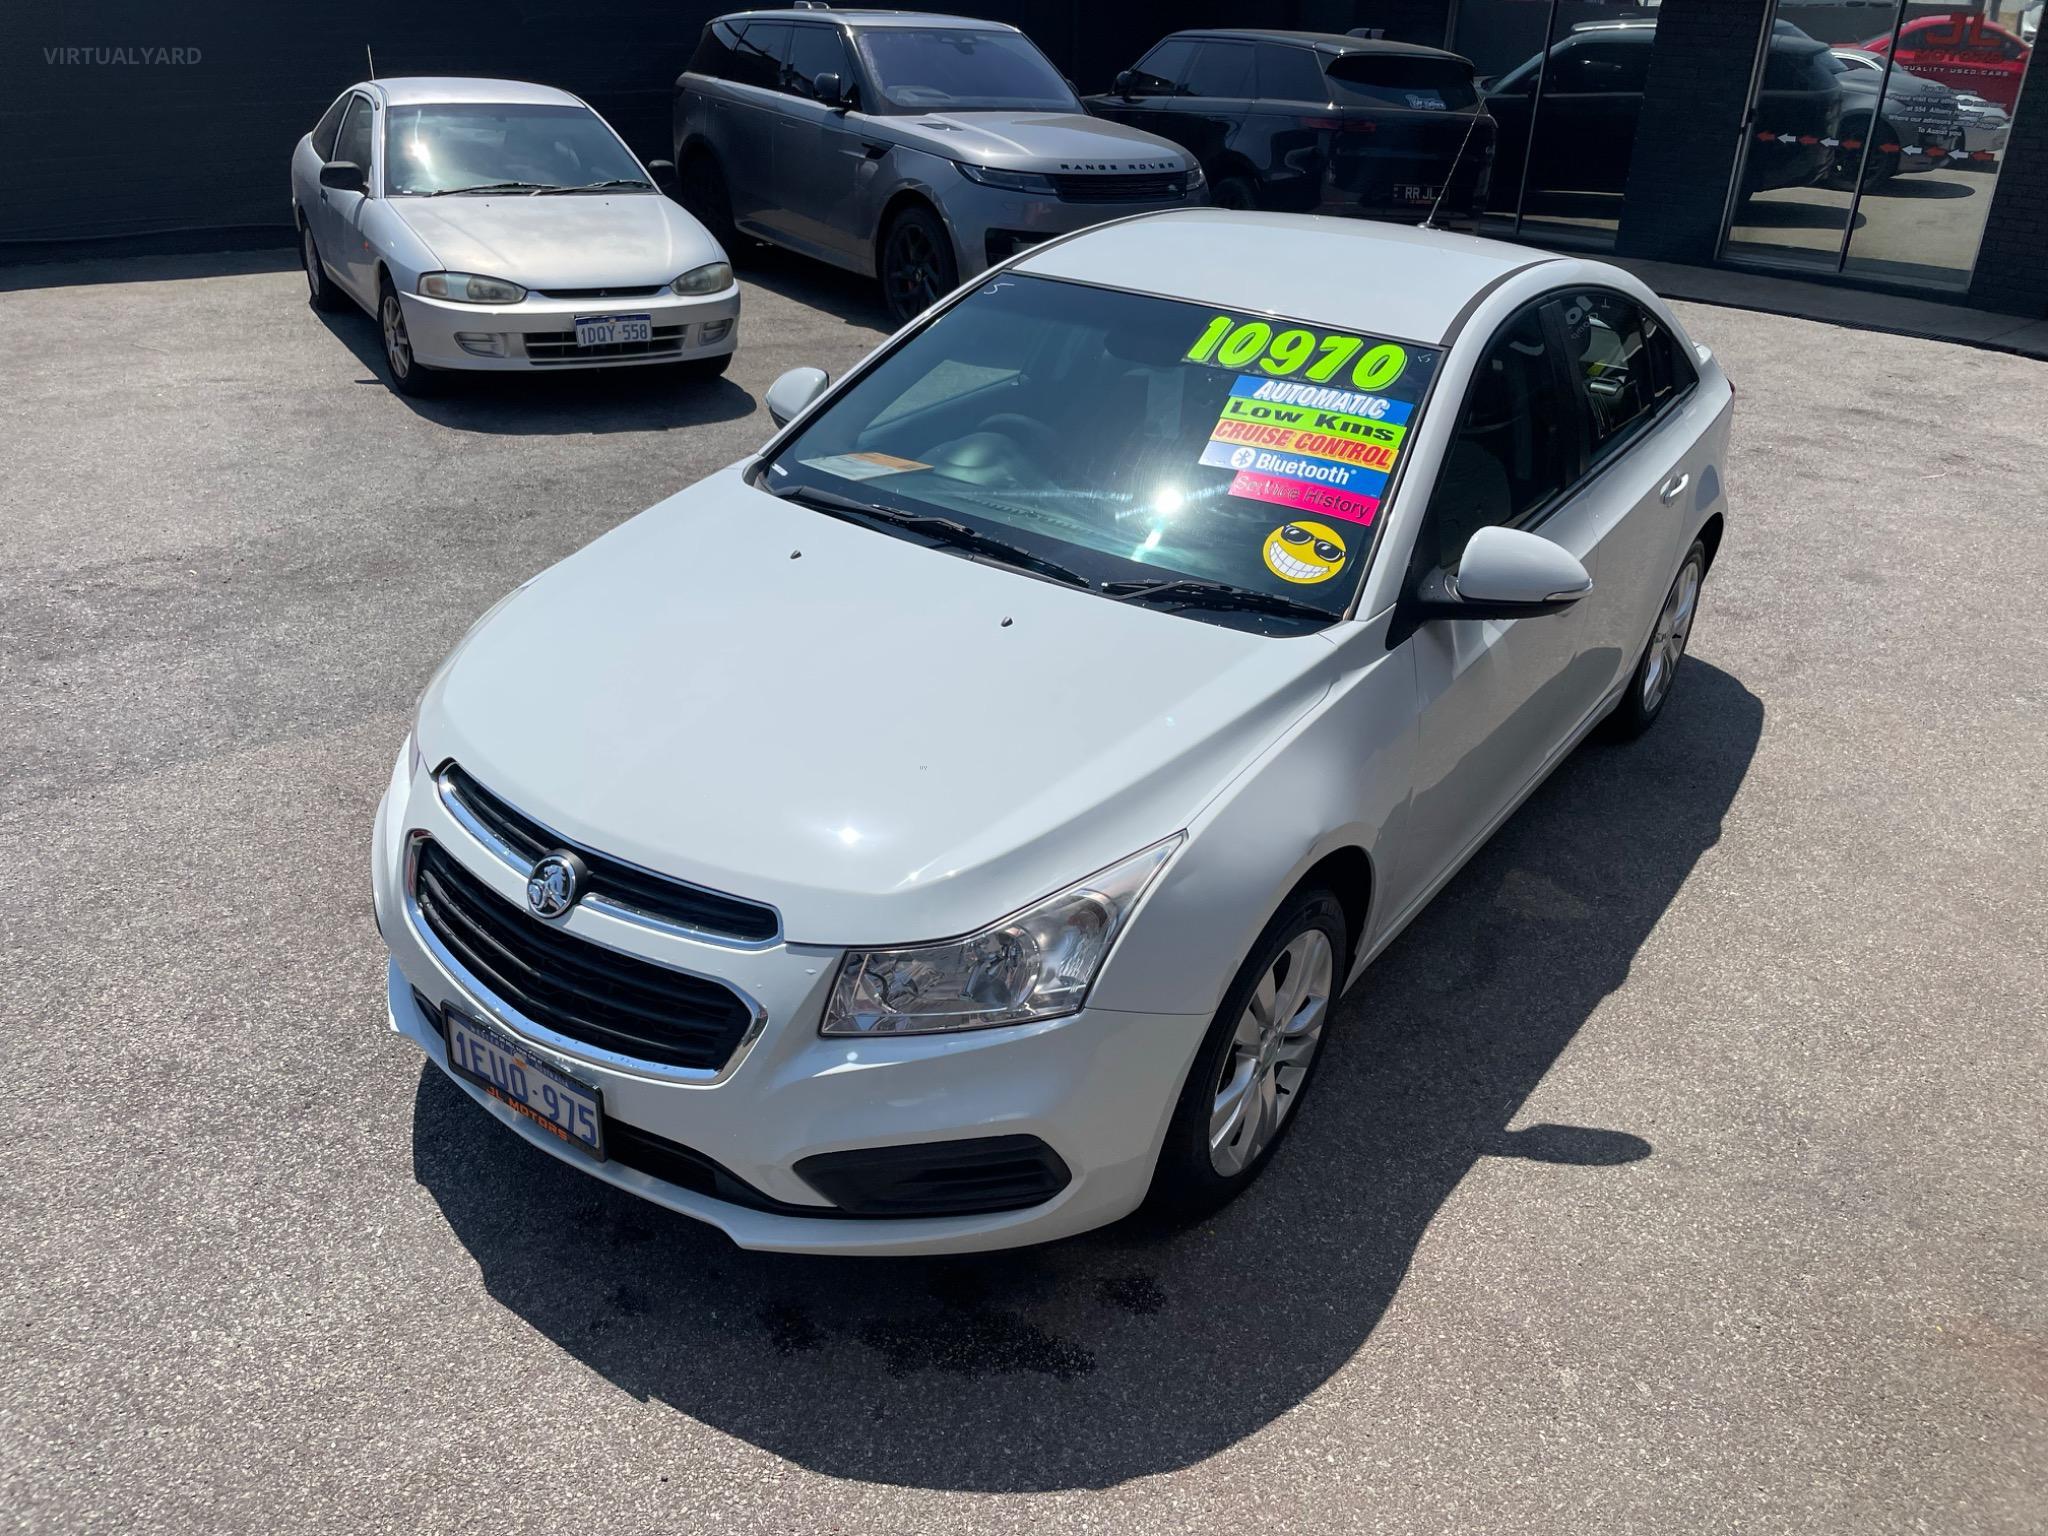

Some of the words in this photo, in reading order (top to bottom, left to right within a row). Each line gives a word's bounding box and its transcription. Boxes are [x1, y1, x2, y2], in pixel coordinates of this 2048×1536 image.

[1926, 12, 2001, 45] JL
[1903, 65, 1945, 73] QUALITY
[1950, 67, 1977, 75] USED
[1981, 69, 2009, 77] CARS
[1918, 126, 1925, 134] To
[1128, 162, 1176, 170] ROVER
[1405, 187, 1420, 199] RR
[1187, 316, 1408, 391] 10970
[1253, 380, 1391, 419] AUTOMATIC
[1229, 400, 1304, 424] Low
[1314, 413, 1395, 442] Kms
[1213, 420, 1295, 448] CRUISE
[1294, 433, 1392, 467] CONTROL
[1302, 486, 1370, 519] History
[508, 1097, 569, 1141] MOTORS
